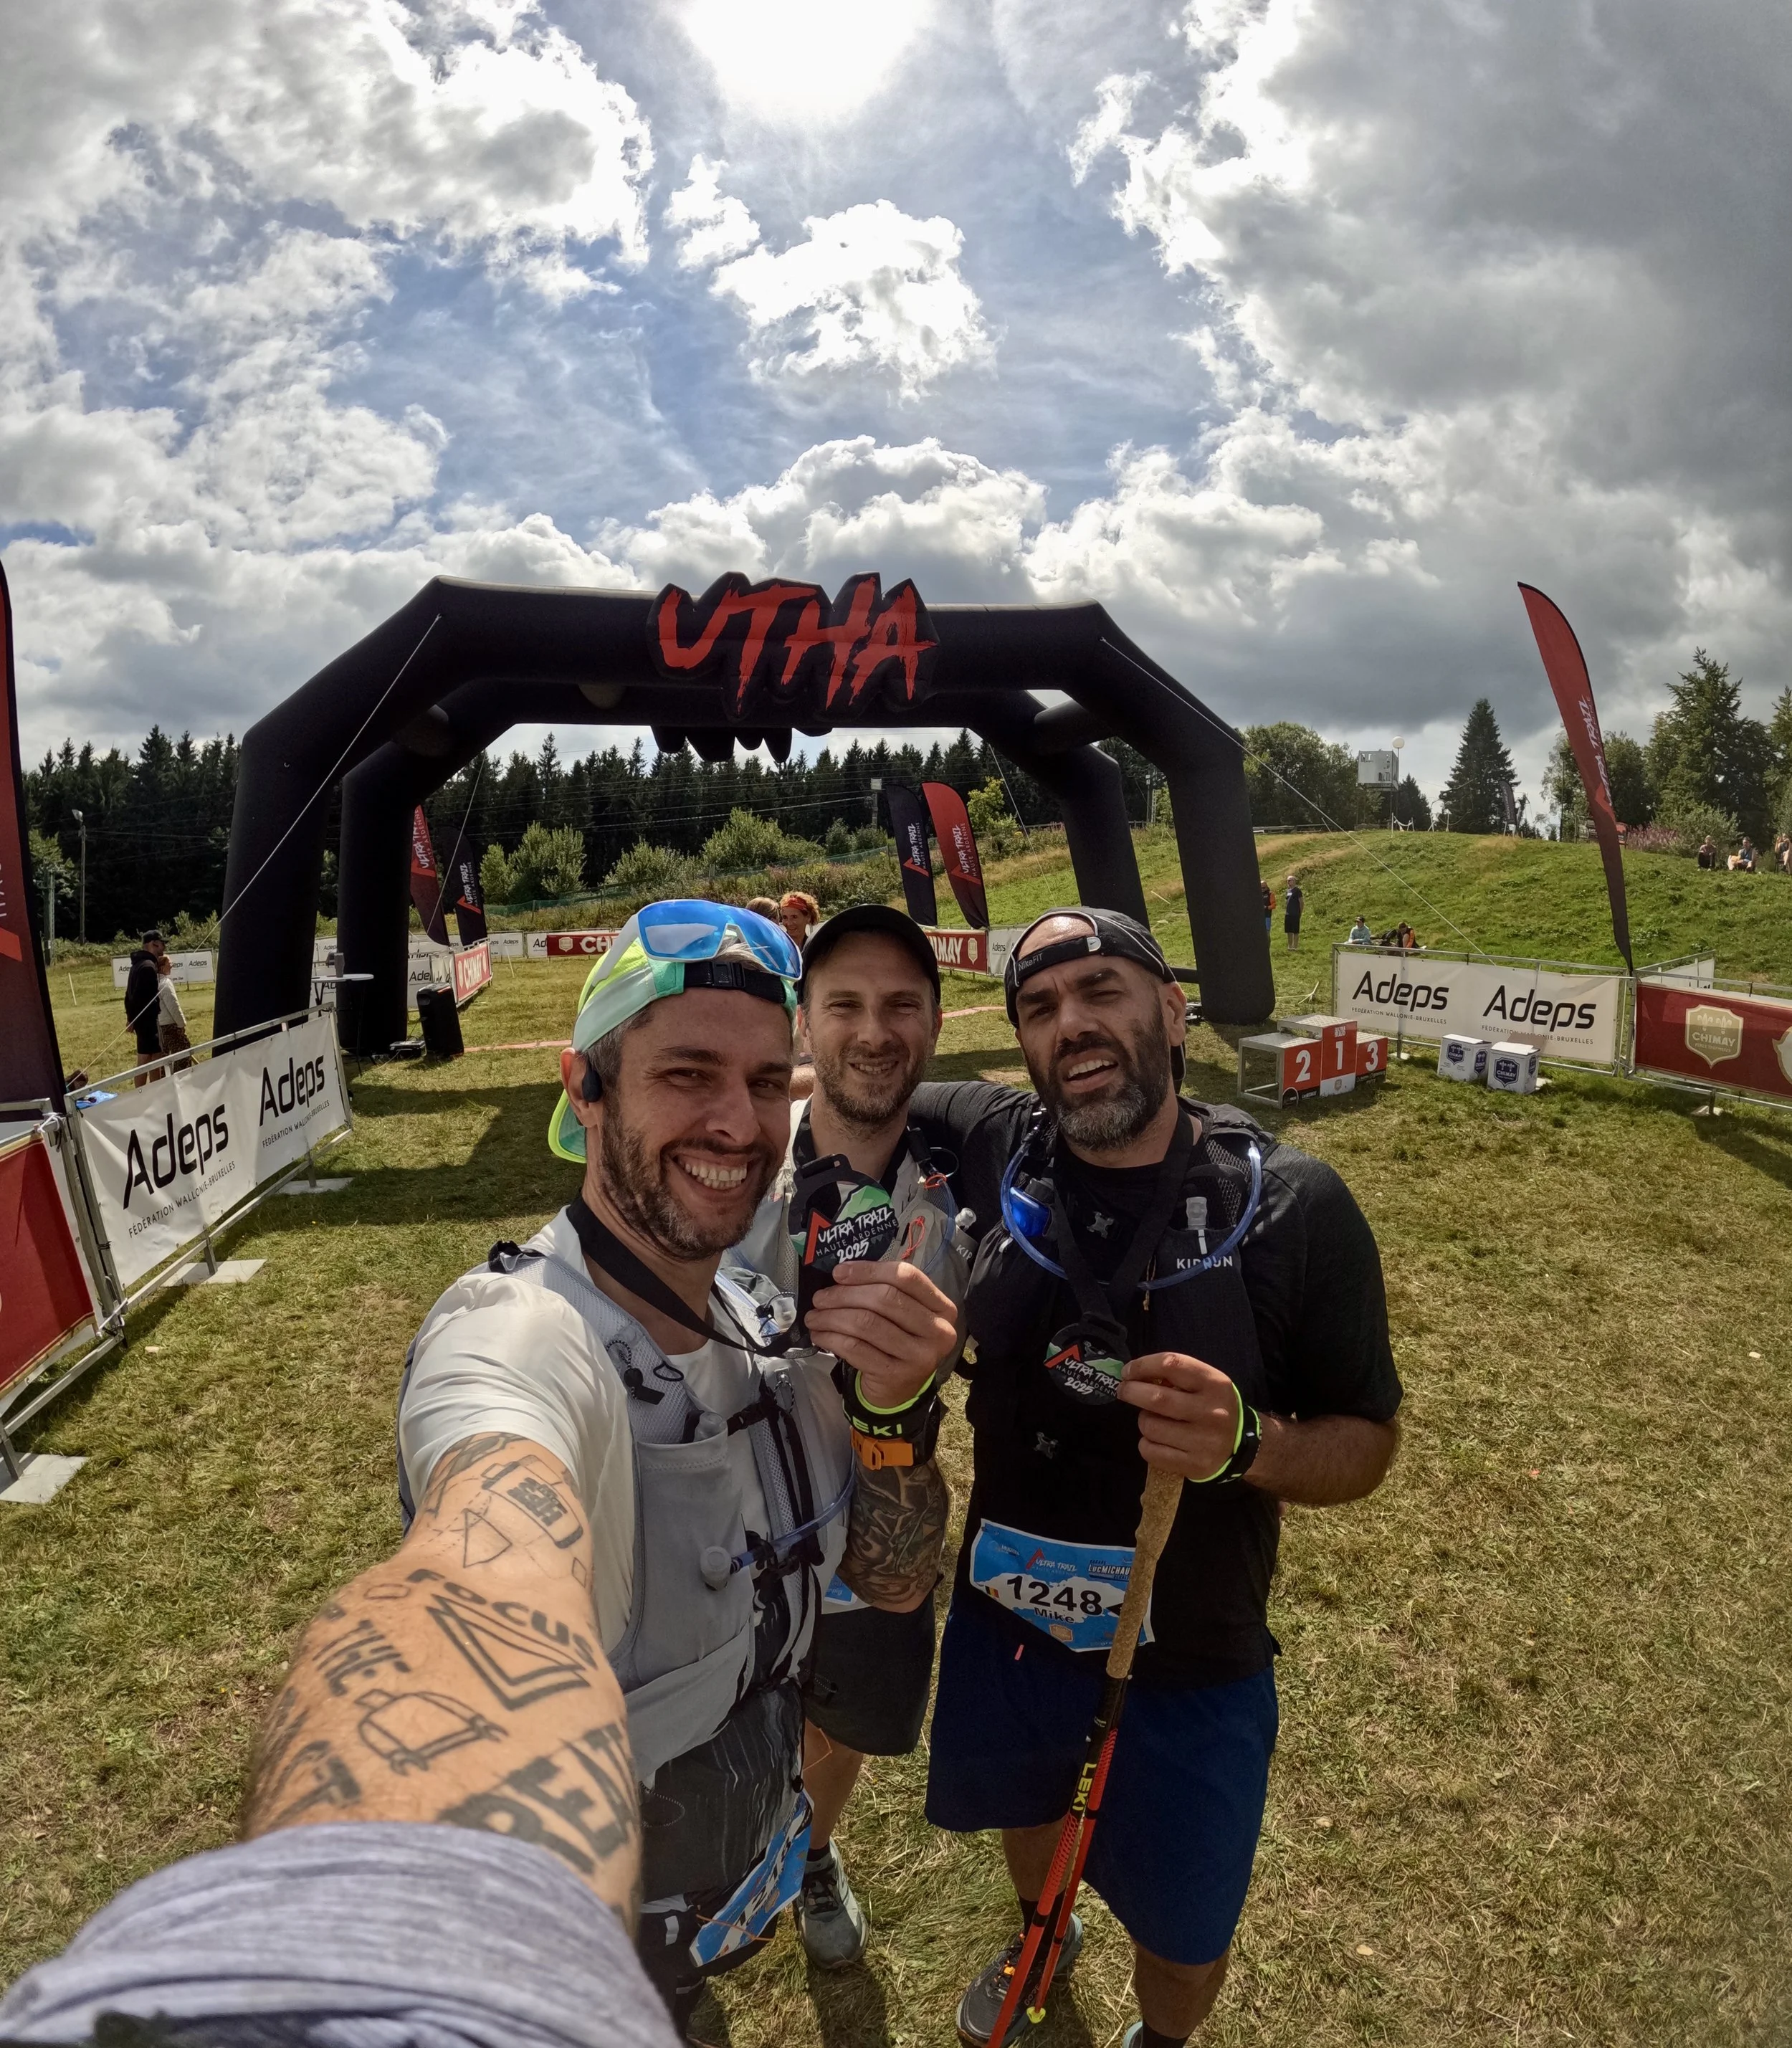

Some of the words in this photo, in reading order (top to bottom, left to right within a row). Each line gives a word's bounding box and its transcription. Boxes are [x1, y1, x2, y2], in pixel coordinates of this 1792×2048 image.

[658, 576, 938, 715] UTHA
[1578, 695, 1599, 749] TRAIL
[908, 823, 918, 845] TRAIL
[952, 824, 964, 849] TRAIL
[413, 842, 430, 869] ULTRA
[911, 845, 922, 866] ULTRA
[958, 849, 970, 874] ULTRA
[459, 862, 470, 883] TRAIL
[463, 883, 474, 904] ULTRA
[992, 942, 1006, 952] Adeps
[409, 971, 430, 982] Ade
[1352, 971, 1449, 1012] Adeps
[1386, 1011, 1447, 1025] WALLONIE-BRUXELLES
[1482, 985, 1597, 1032] Adeps
[1692, 1032, 1736, 1047] CHIMAY
[1295, 1049, 1311, 1083] 2
[1335, 1041, 1344, 1070] 1
[1366, 1042, 1379, 1072] 3
[259, 1055, 325, 1127] Adeps
[123, 1104, 229, 1210] Adeps
[175, 1161, 236, 1208] WALLONIE-BRUXELLES
[816, 1239, 847, 1257] HAUTE
[852, 1219, 897, 1242] ARDENNE
[818, 1220, 855, 1244] ULTRA
[855, 1206, 894, 1230] TRAIL
[837, 1238, 869, 1264] 2025
[956, 1244, 973, 1260] KIP
[1064, 1358, 1095, 1377] ULTRA
[1056, 1365, 1080, 1380] HAUTE
[1085, 1378, 1117, 1397] ARDENN
[1064, 1377, 1095, 1395] 2025
[852, 1416, 902, 1437] EKI
[1036, 1558, 1056, 1568] ULTRA
[1057, 1563, 1078, 1572] TRAIL
[1089, 1564, 1130, 1575] LucMICHAU
[1007, 1575, 1104, 1616] 1248
[406, 1568, 599, 1670] FOCUS
[1034, 1607, 1075, 1624] Mike
[1072, 1763, 1097, 1811] LEKI
